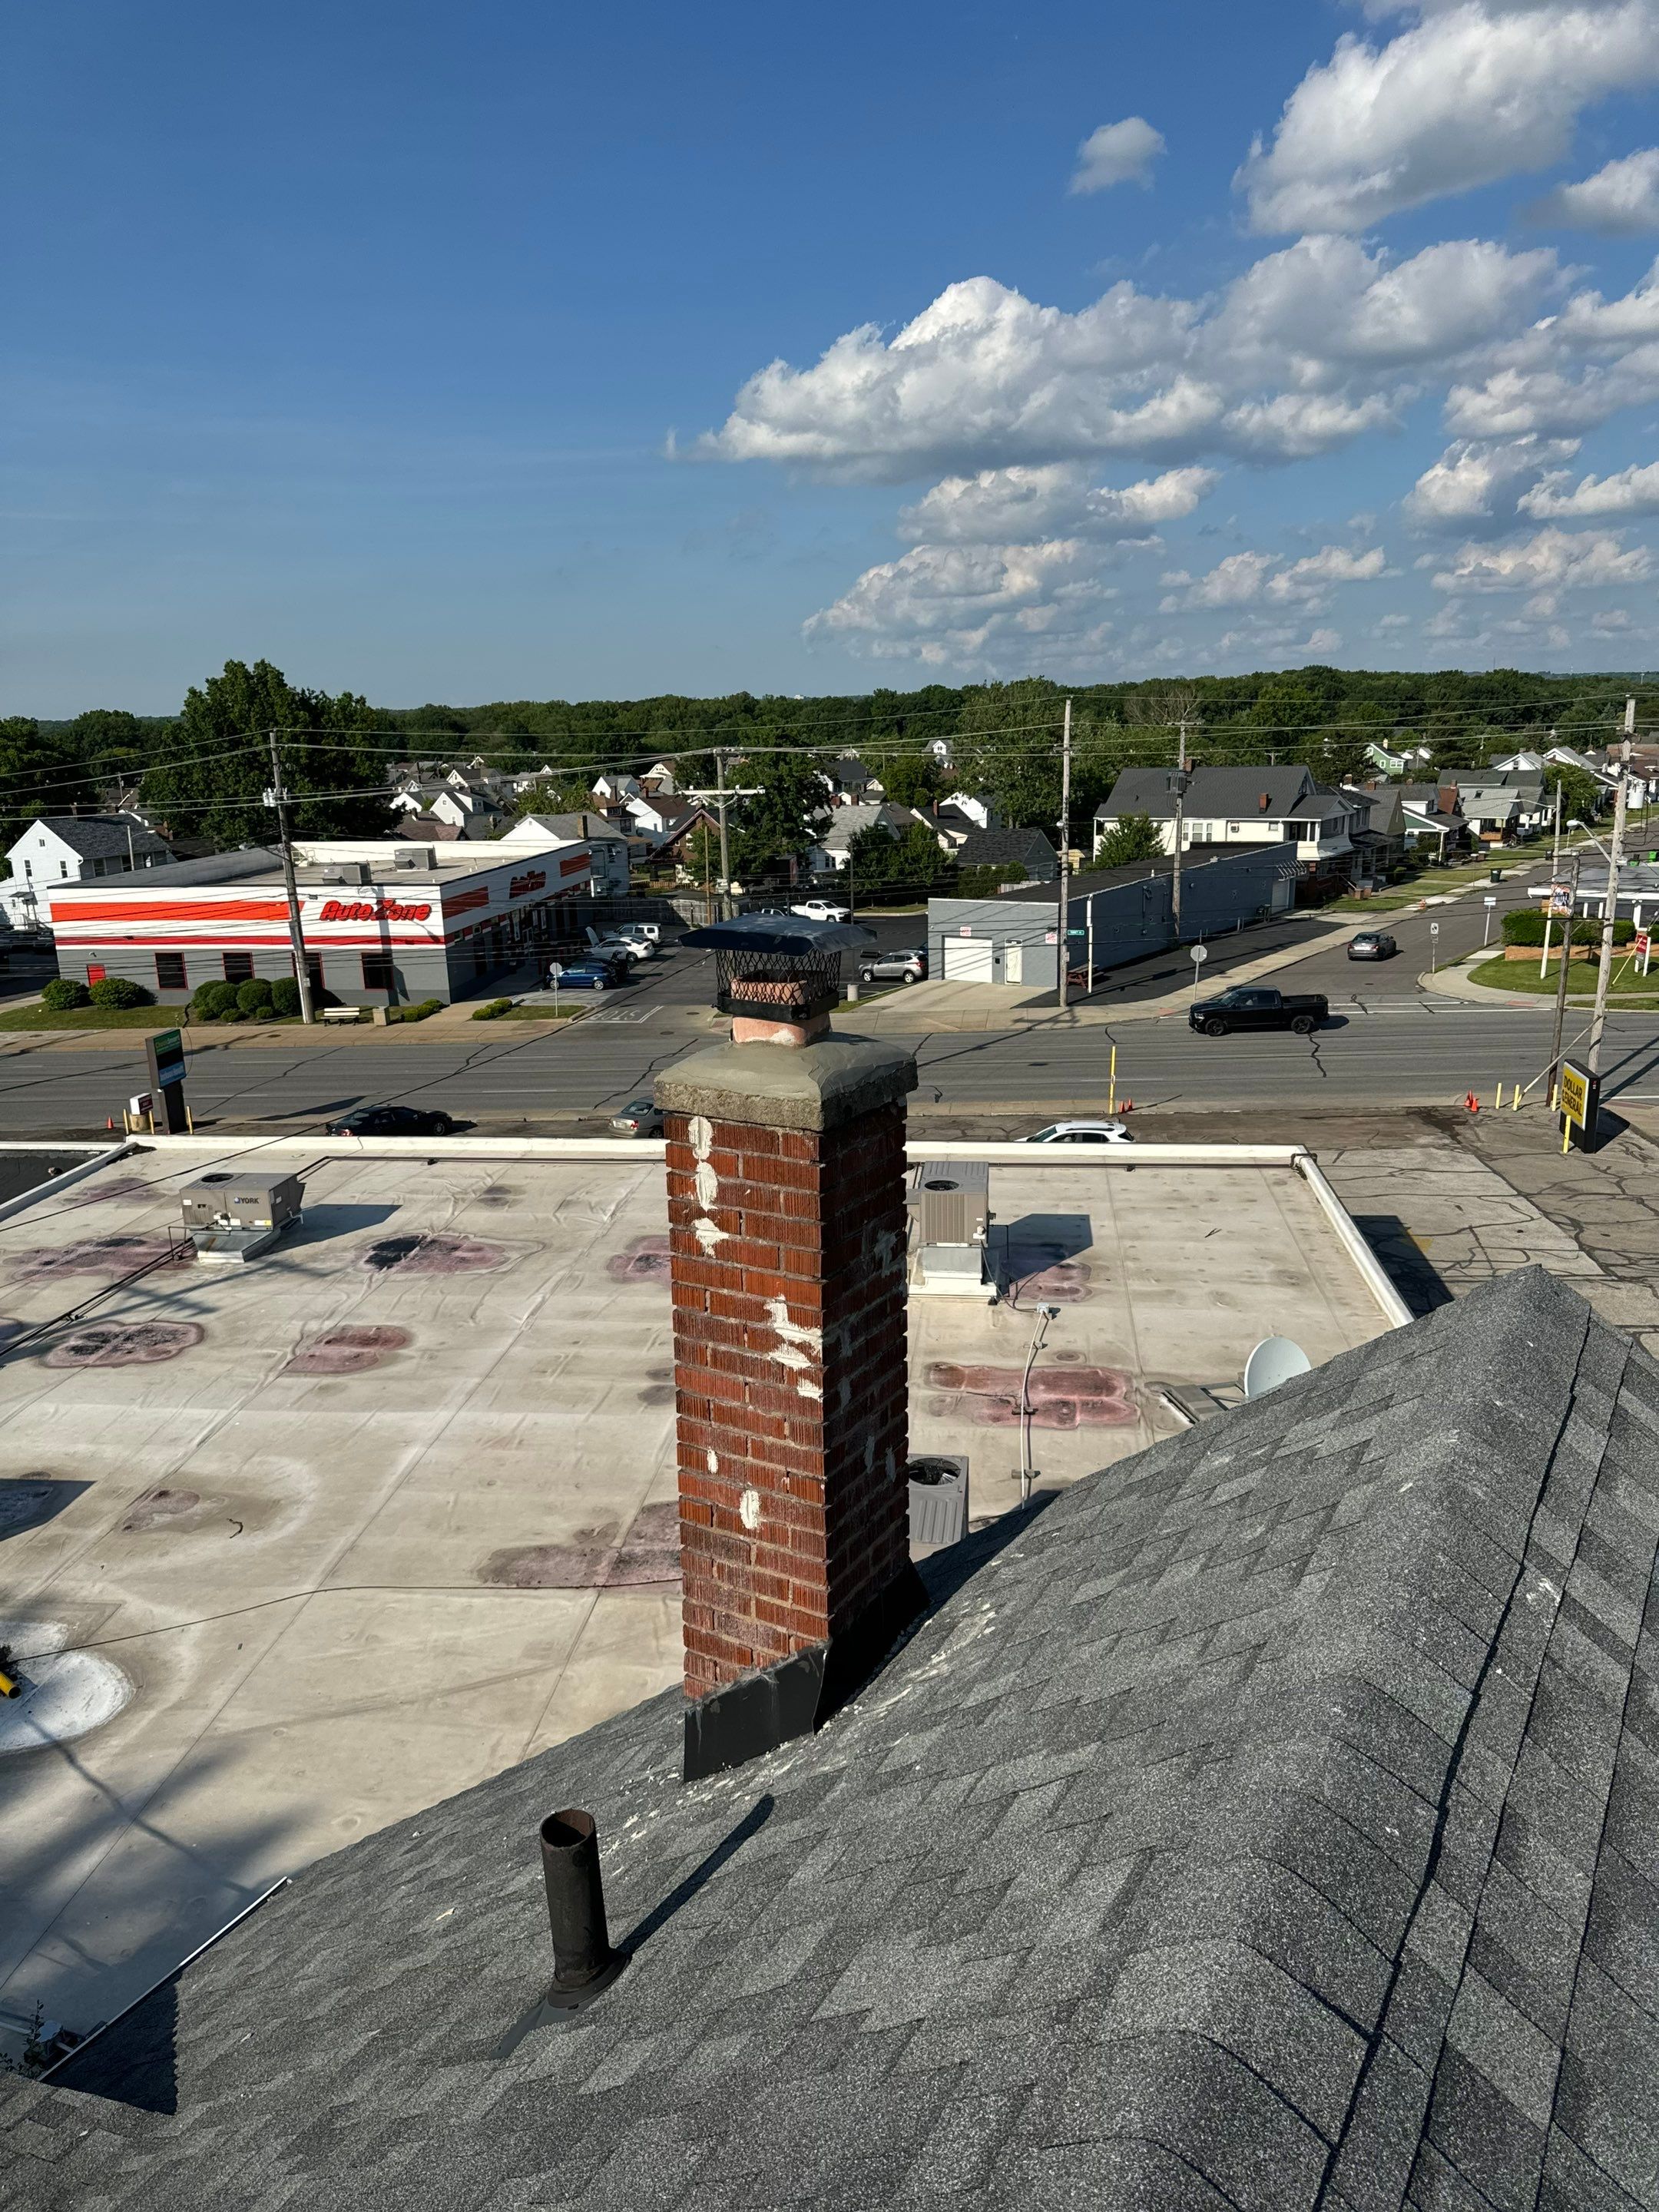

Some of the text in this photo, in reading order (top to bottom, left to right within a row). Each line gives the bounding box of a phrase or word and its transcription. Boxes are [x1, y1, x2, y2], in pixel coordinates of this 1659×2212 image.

[320, 898, 432, 921] AutoZone
[1564, 1075, 1583, 1101] DOLLAR
[1561, 1088, 1582, 1117] GENERAL
